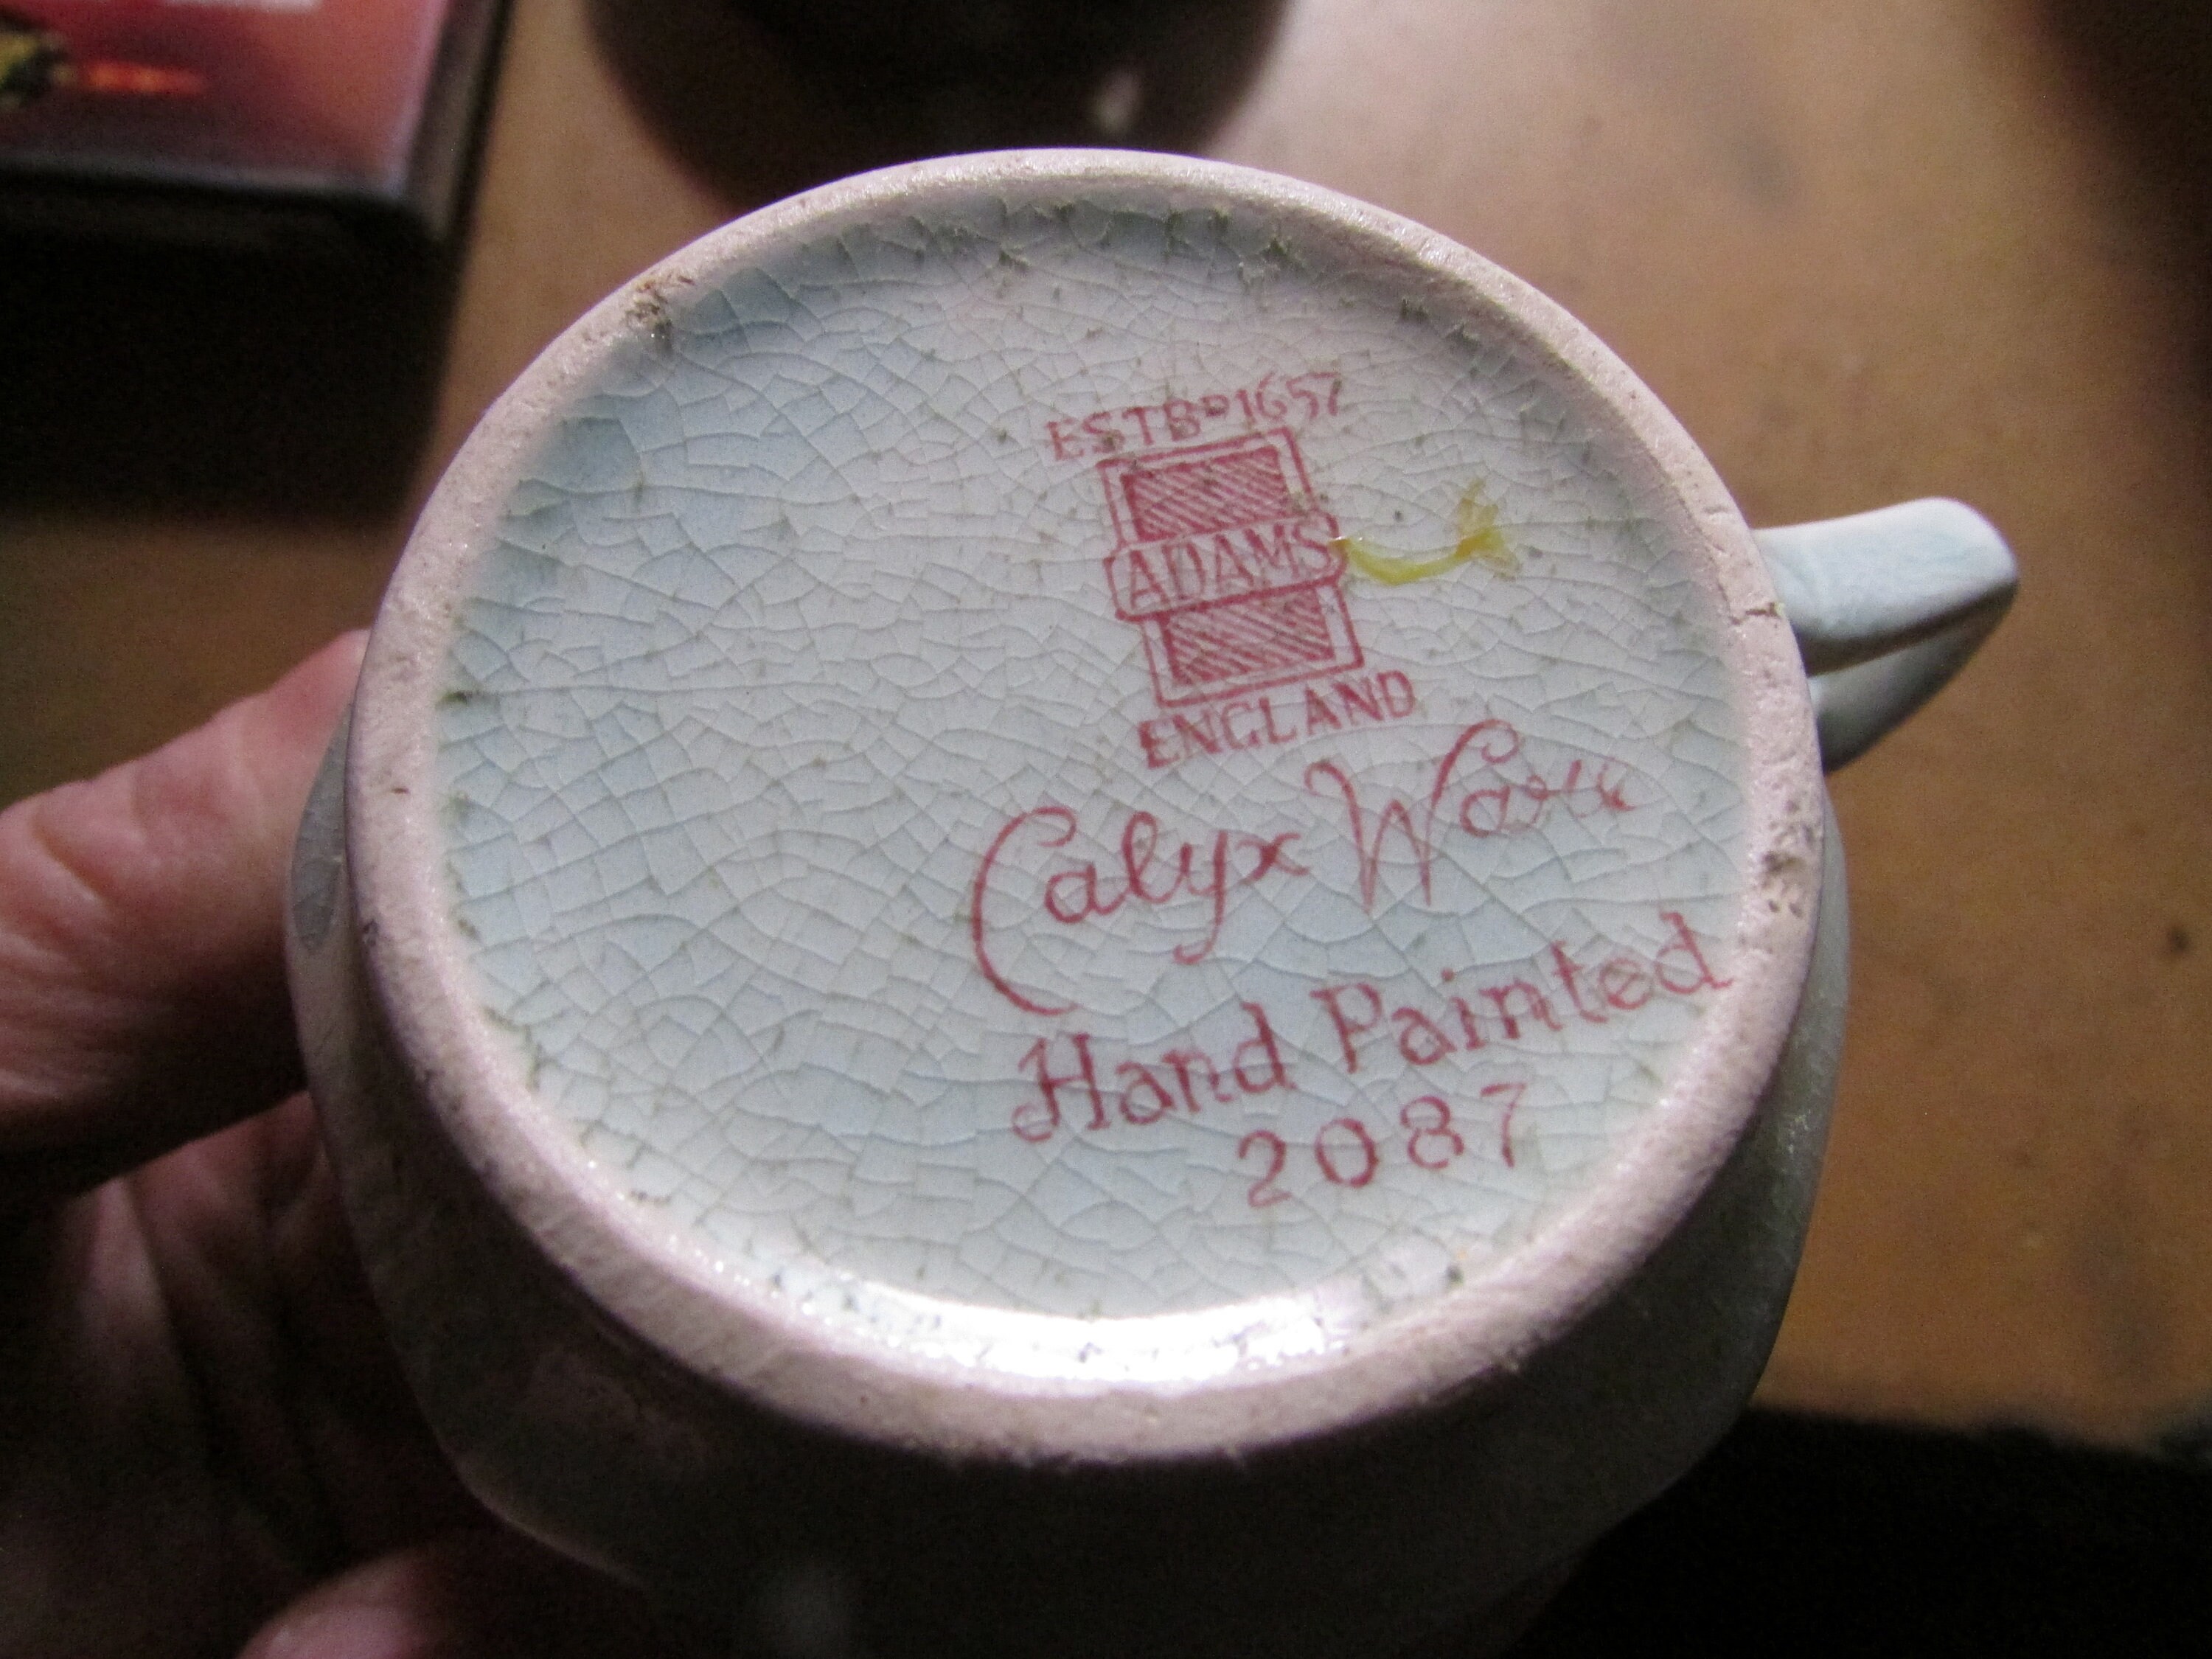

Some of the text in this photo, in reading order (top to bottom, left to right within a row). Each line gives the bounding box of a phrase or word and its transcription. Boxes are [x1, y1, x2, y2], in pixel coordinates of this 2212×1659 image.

[1236, 371, 1341, 425] 1657
[1130, 518, 1335, 610] ADAMS
[1136, 669, 1417, 769] ENGLAND
[972, 806, 1311, 1016] Calyx
[1012, 911, 1733, 1143] Hand Painted
[1239, 1082, 1526, 1208] 2087
